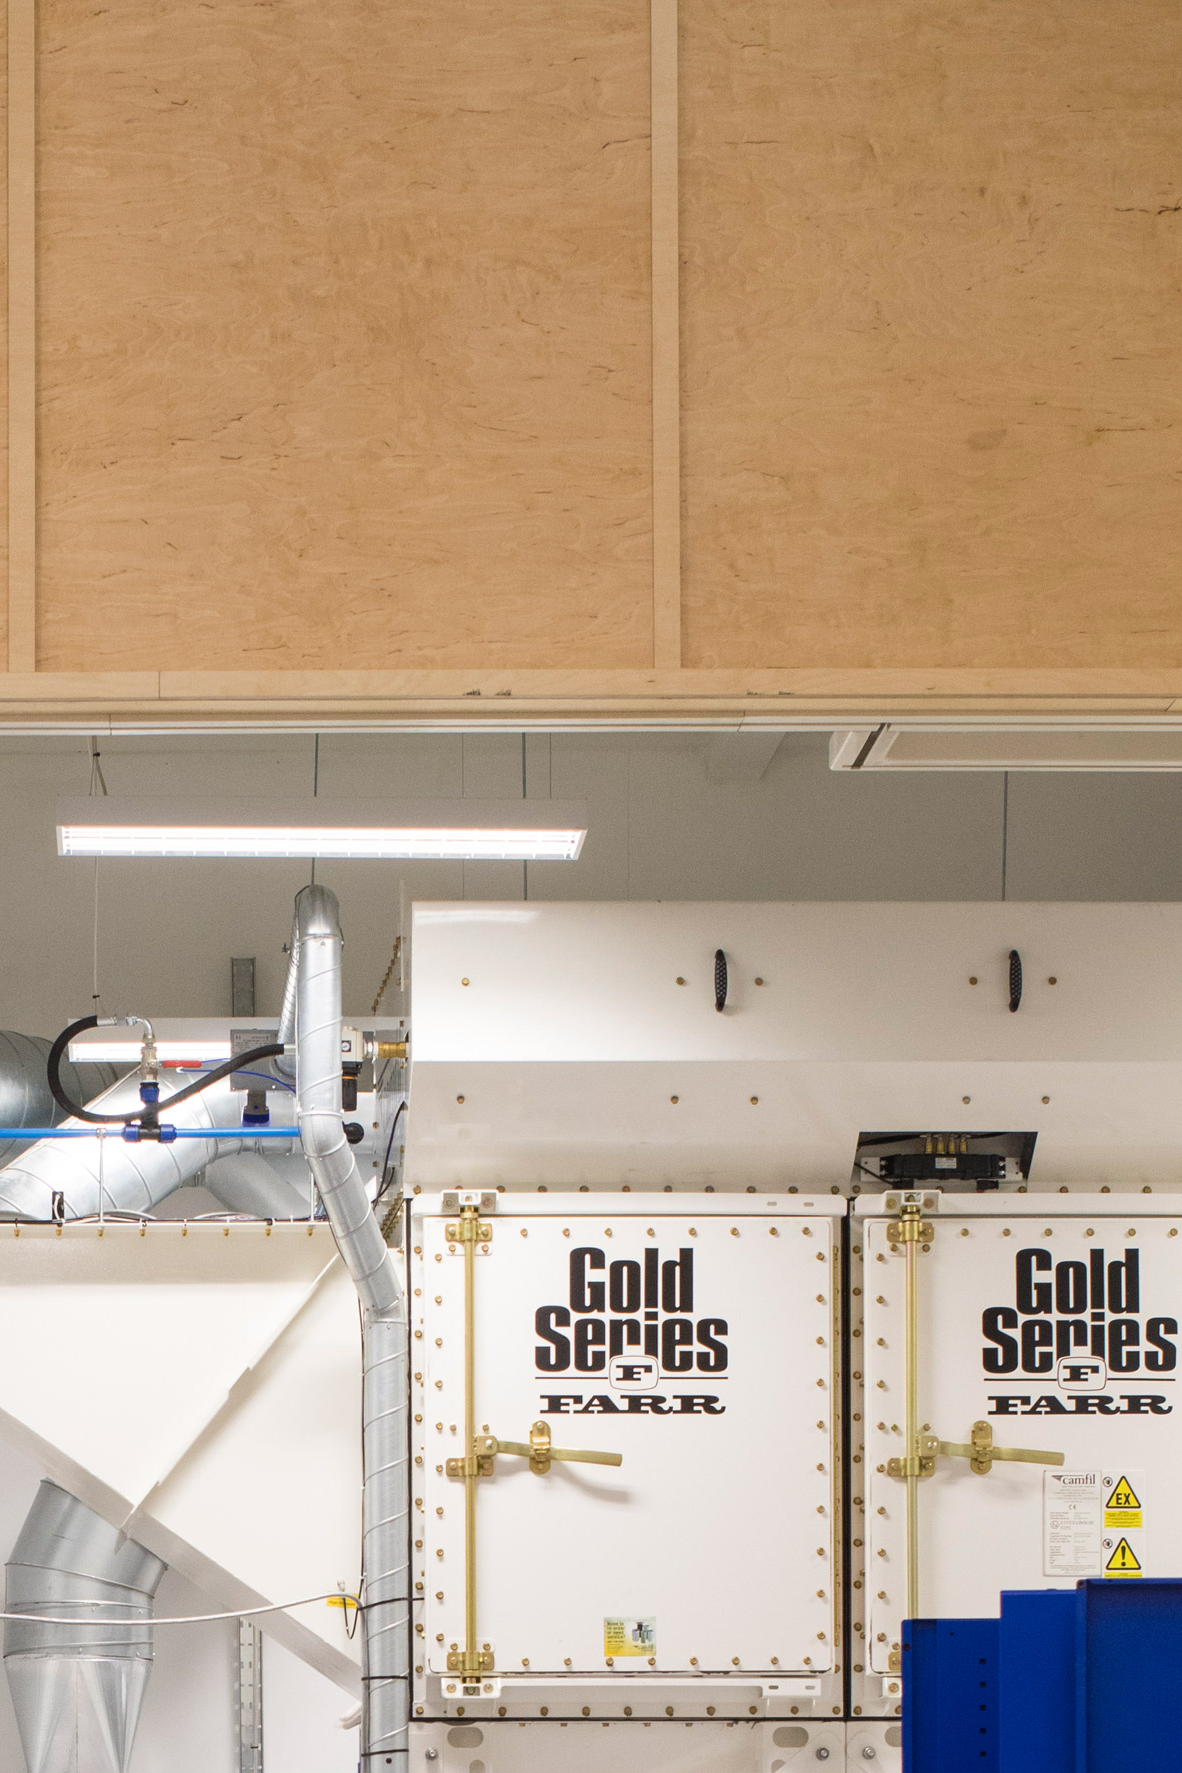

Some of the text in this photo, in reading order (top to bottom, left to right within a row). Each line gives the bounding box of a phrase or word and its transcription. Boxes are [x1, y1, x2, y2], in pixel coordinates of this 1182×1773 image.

[570, 1247, 694, 1313] Gold
[1016, 1248, 1140, 1315] Gold
[535, 1305, 728, 1372] Series
[982, 1307, 1178, 1374] Series
[616, 1364, 653, 1381] F
[1063, 1365, 1100, 1382] F
[540, 1394, 726, 1415] FARR
[987, 1395, 1173, 1415] FARR
[1062, 1473, 1096, 1485] camfil
[1115, 1493, 1131, 1505] EX
